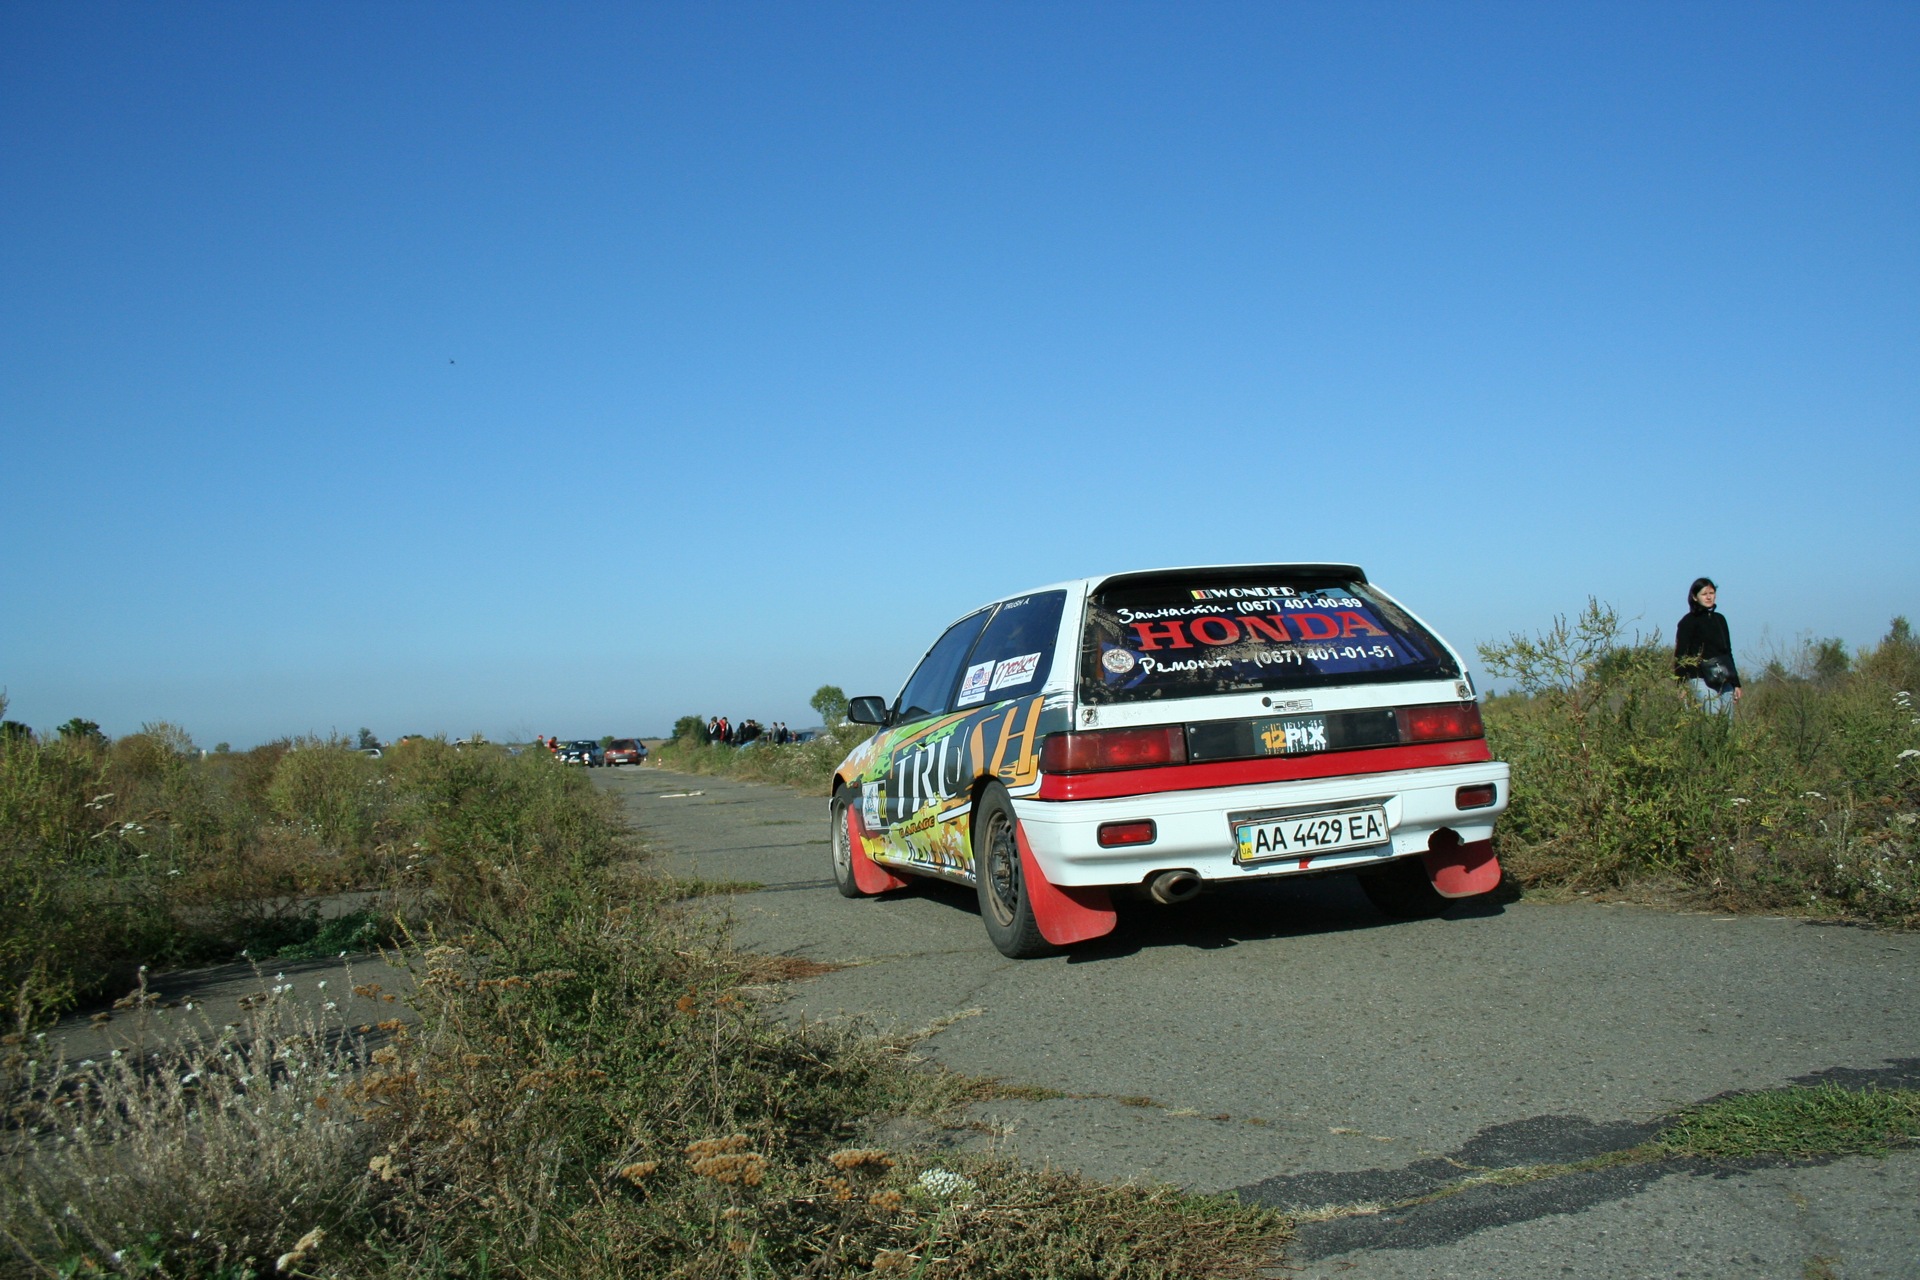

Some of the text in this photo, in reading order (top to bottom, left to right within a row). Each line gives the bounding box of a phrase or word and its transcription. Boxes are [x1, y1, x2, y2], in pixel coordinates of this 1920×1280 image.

[1209, 586, 1297, 599] WONDER
[1236, 600, 1281, 614] (067)
[1284, 597, 1363, 610] 401-00-89
[1129, 610, 1389, 651] HONDA
[1254, 649, 1302, 668] (067)
[1306, 645, 1395, 661] 401-01-51
[1255, 814, 1381, 853] AA 4429 EA
[1241, 847, 1253, 855] UA
